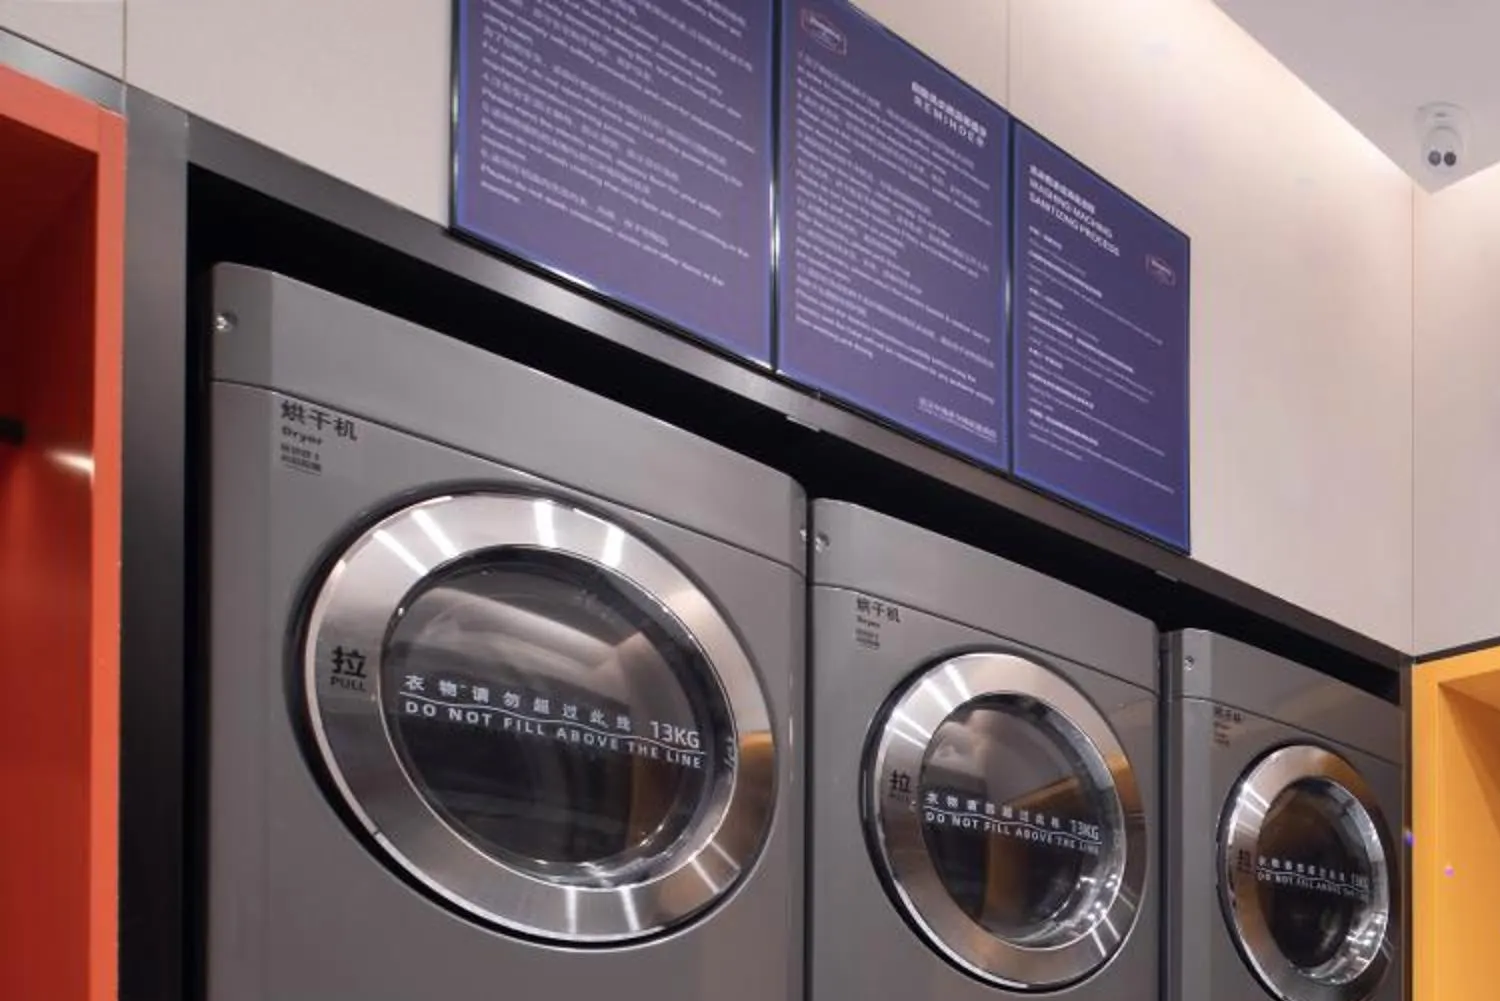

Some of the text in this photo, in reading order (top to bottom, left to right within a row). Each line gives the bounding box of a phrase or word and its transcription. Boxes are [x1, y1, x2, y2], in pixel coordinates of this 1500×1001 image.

[281, 400, 357, 441] 烘干机
[332, 646, 366, 678] 拉
[331, 676, 366, 692] PULL
[405, 701, 701, 769] DO NOT FILL ABOVE THE LINE
[650, 721, 700, 748] 13KG
[890, 769, 911, 793] 拉
[925, 811, 945, 824] DO
[951, 814, 979, 830] NOT
[983, 820, 1011, 836] FILL
[1070, 819, 1100, 841] 13KG
